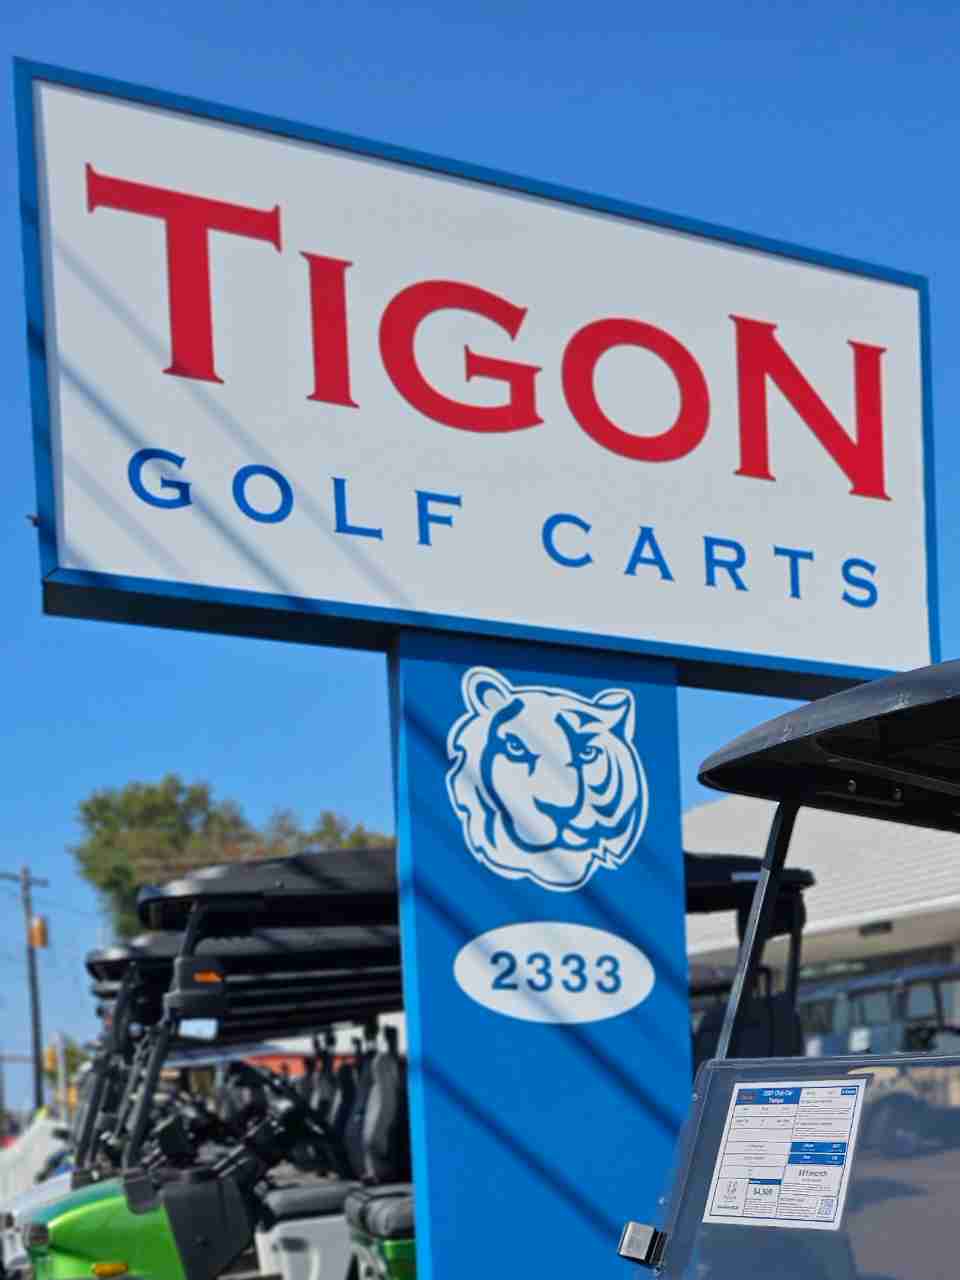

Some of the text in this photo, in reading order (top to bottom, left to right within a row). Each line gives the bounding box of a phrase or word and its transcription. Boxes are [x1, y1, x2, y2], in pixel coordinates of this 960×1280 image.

[85, 162, 892, 501] TIGON
[127, 448, 880, 609] GOLF CARTS
[489, 950, 622, 994] 2333
